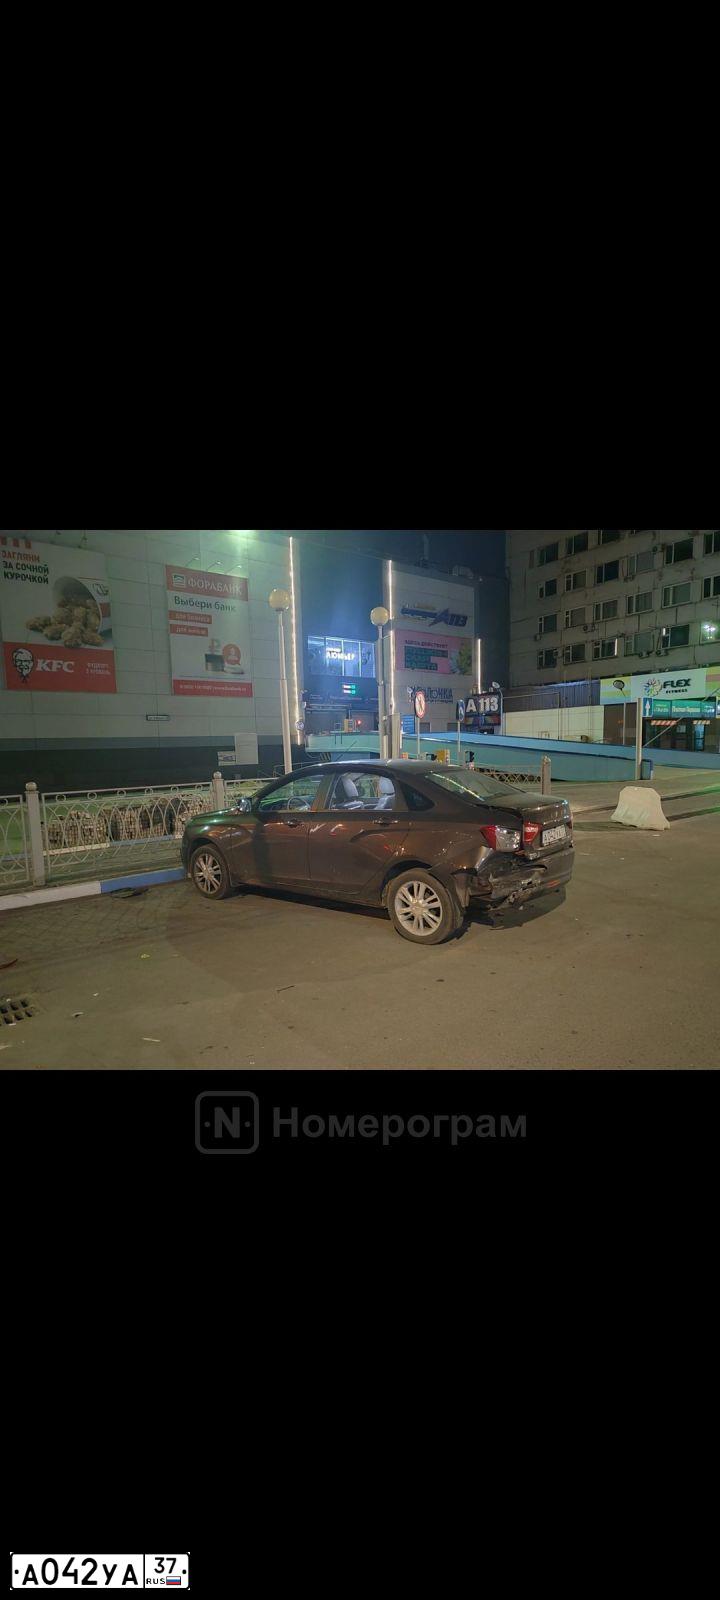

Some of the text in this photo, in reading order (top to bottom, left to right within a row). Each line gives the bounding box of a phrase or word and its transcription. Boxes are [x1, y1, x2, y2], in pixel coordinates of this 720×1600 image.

[2, 550, 40, 562] ЗАГЛЯНИ
[2, 561, 49, 574] ЗА СОЧНОЙ
[4, 570, 49, 584] КУРОЧКОЙ
[187, 576, 242, 595] ФОРАБАНК
[174, 595, 237, 612] Выбери банк
[36, 658, 75, 673] KFC
[663, 678, 691, 688] FLEX
[478, 697, 499, 713] 113
